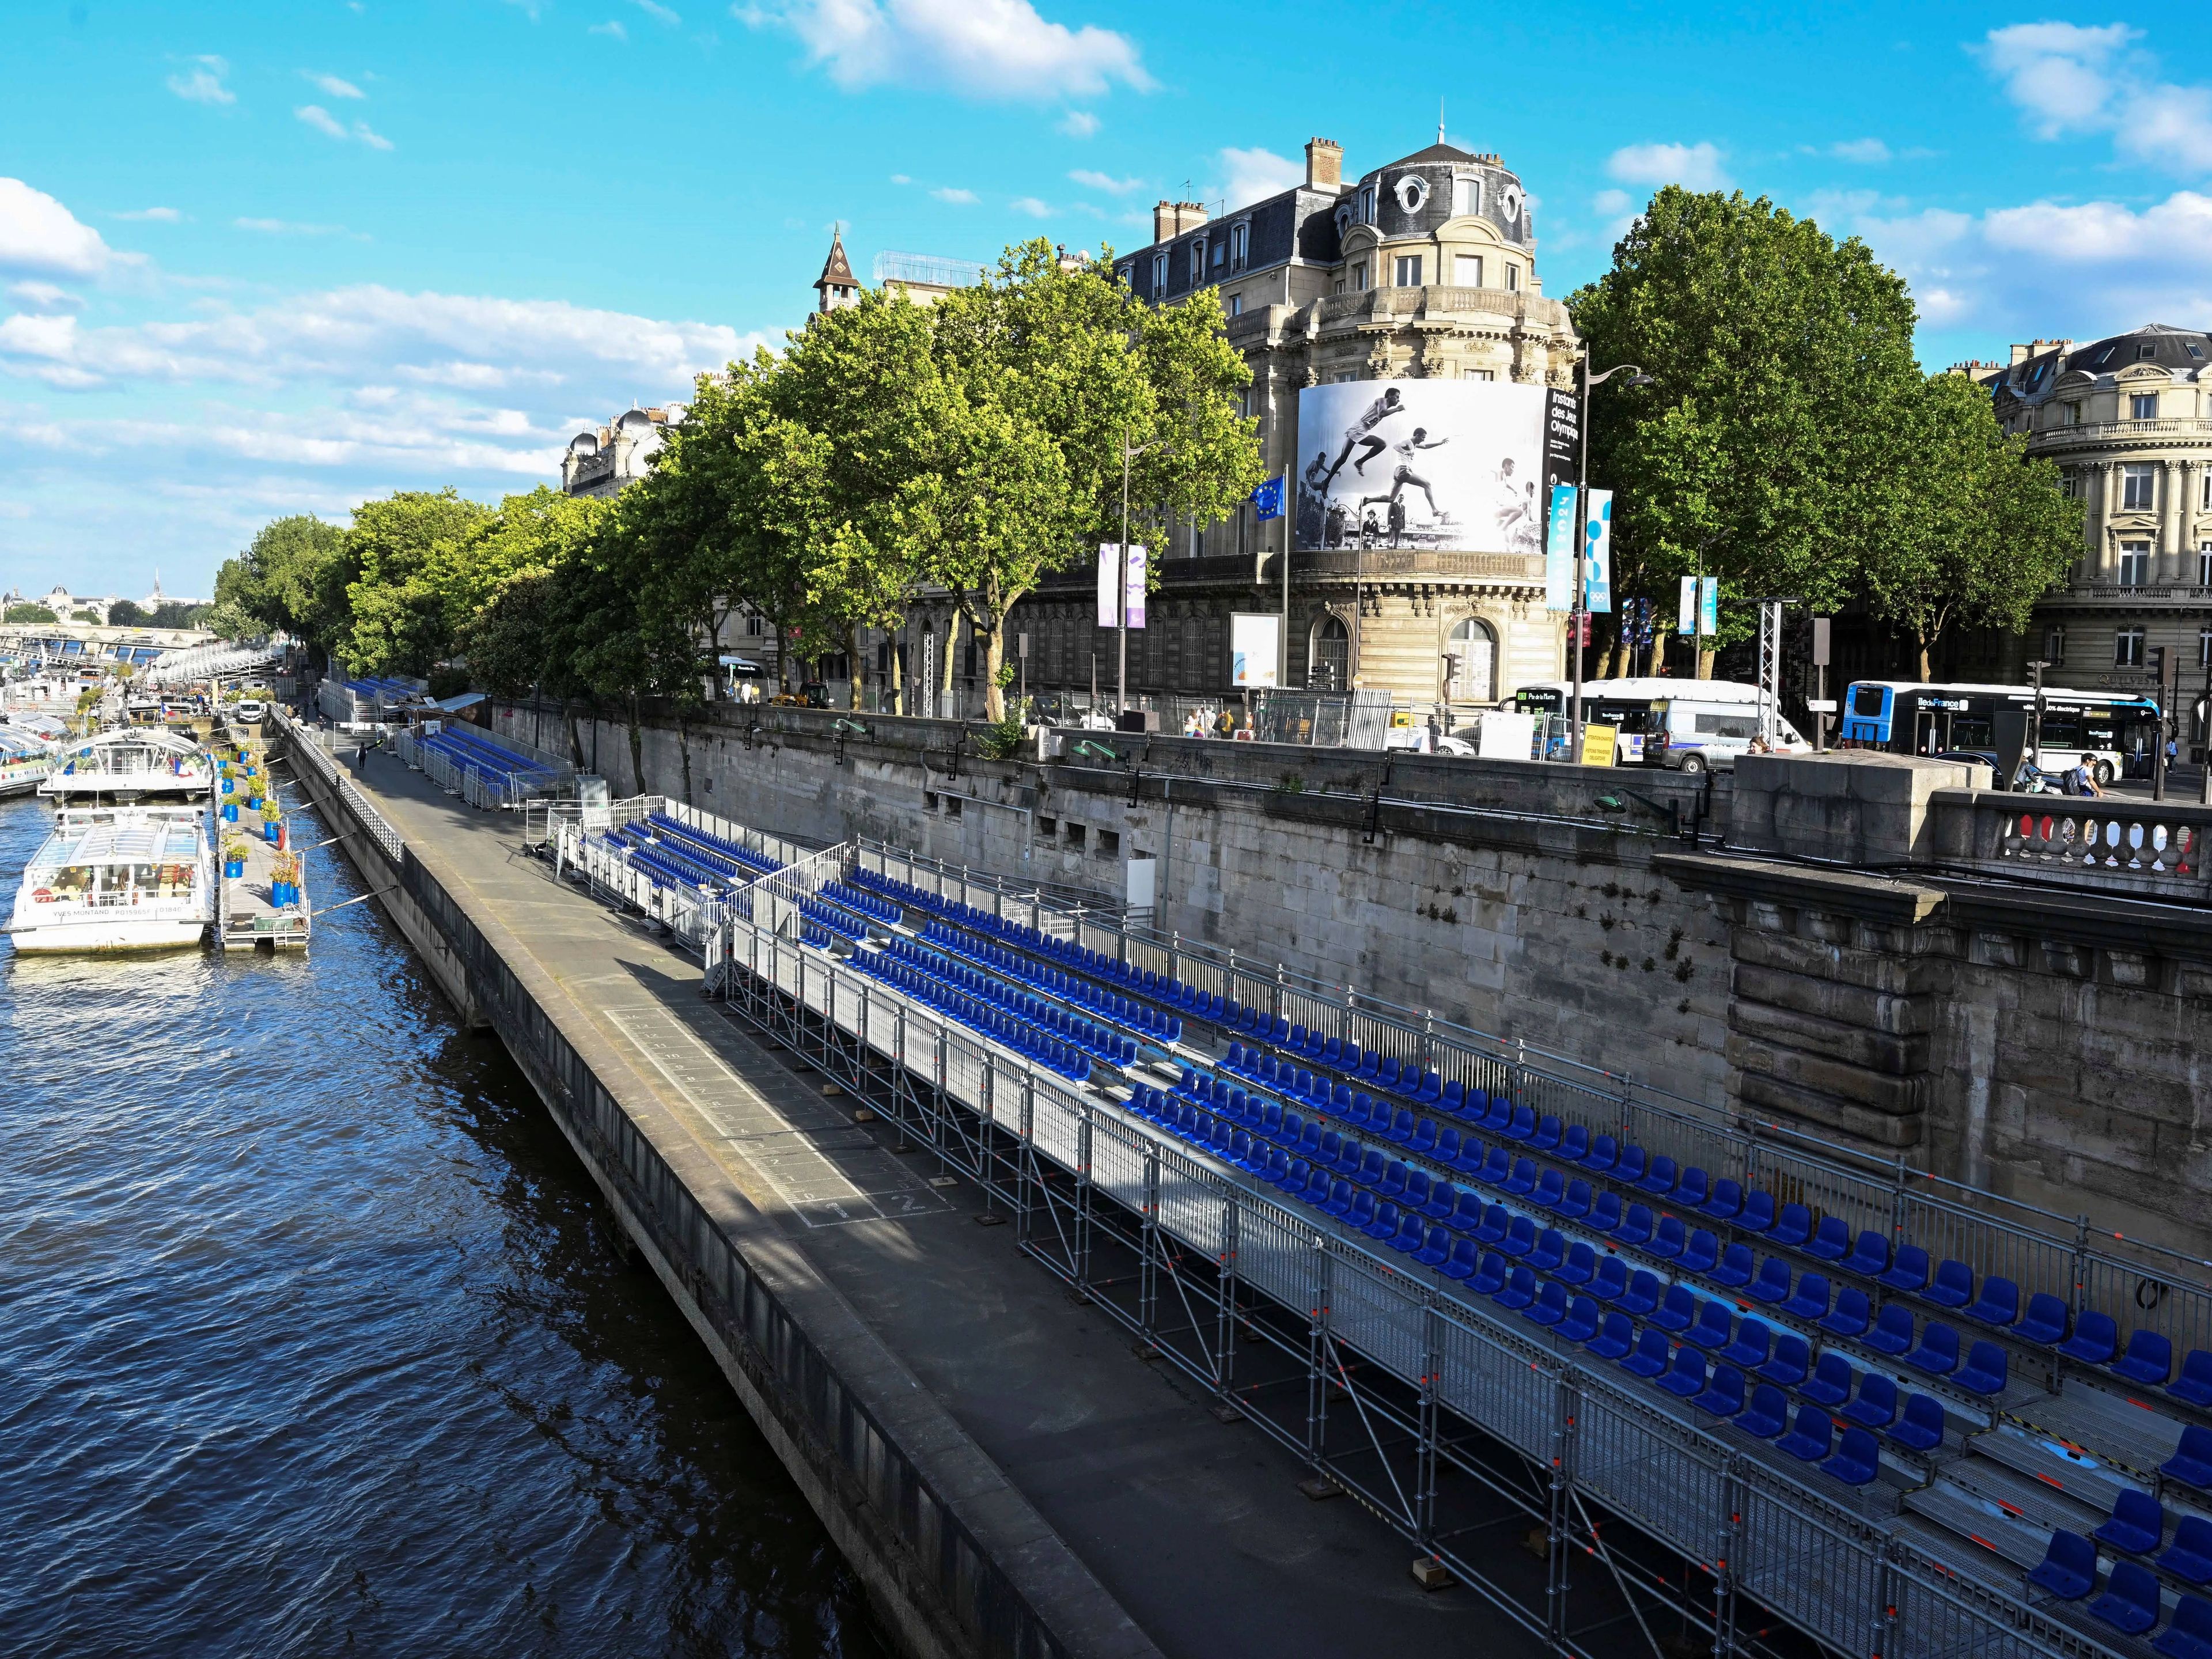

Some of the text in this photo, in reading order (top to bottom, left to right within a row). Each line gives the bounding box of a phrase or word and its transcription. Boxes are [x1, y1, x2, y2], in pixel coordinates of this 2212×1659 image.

[1553, 391, 1576, 409] Instants
[1552, 406, 1577, 424] des Jeux
[1556, 496, 1569, 542] 2024
[825, 1202, 850, 1219] 1
[891, 1195, 926, 1211] 2
